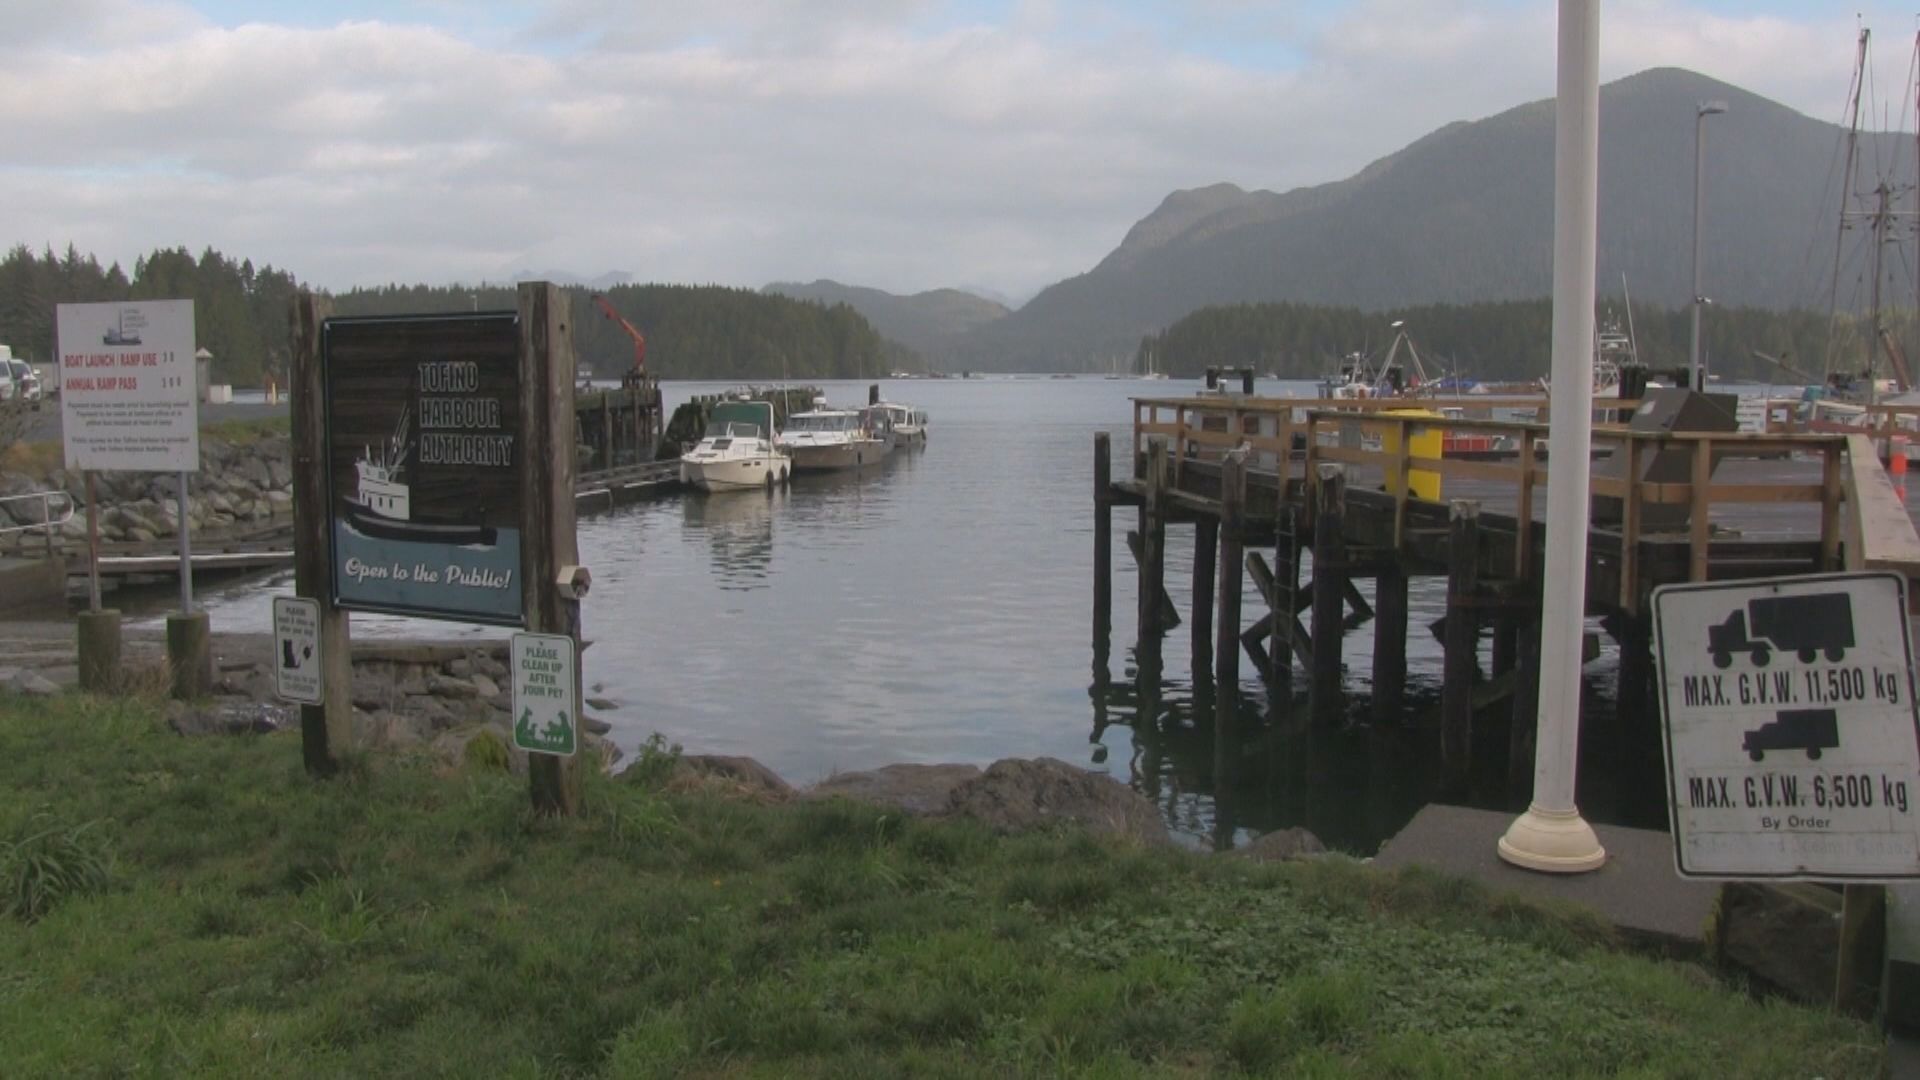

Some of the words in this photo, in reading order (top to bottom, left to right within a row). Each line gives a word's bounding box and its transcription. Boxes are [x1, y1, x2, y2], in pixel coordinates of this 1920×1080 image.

[65, 354, 83, 368] BOAT
[85, 354, 115, 368] LAUNCH
[120, 353, 142, 367] RAMP
[143, 353, 158, 367] USE
[66, 378, 95, 390] ANNUAL
[119, 377, 137, 390] PASS
[418, 361, 479, 392] TOFINO
[419, 397, 501, 428] HARBOUR
[420, 433, 514, 466] AUTHORITY
[345, 557, 388, 584] Open
[393, 562, 409, 581] to
[414, 563, 438, 583] the
[446, 564, 511, 589] Public!
[526, 646, 558, 660] PLEASE
[522, 659, 549, 672] CLEAN
[551, 662, 563, 673] UP
[528, 673, 556, 685] AFTER
[1684, 675, 1731, 707] MAX.
[1739, 671, 1798, 705] G.V.W.
[1805, 667, 1865, 706] 11,500
[1873, 666, 1898, 704] kg
[523, 685, 545, 697] YOUR
[548, 687, 564, 698] PET
[1689, 776, 1736, 809] MAX.
[1744, 775, 1805, 808] G.V.W.
[1814, 774, 1873, 811] 6,500
[1883, 774, 1907, 812] kg
[1762, 816, 1780, 830] By
[1788, 815, 1831, 829] Order
